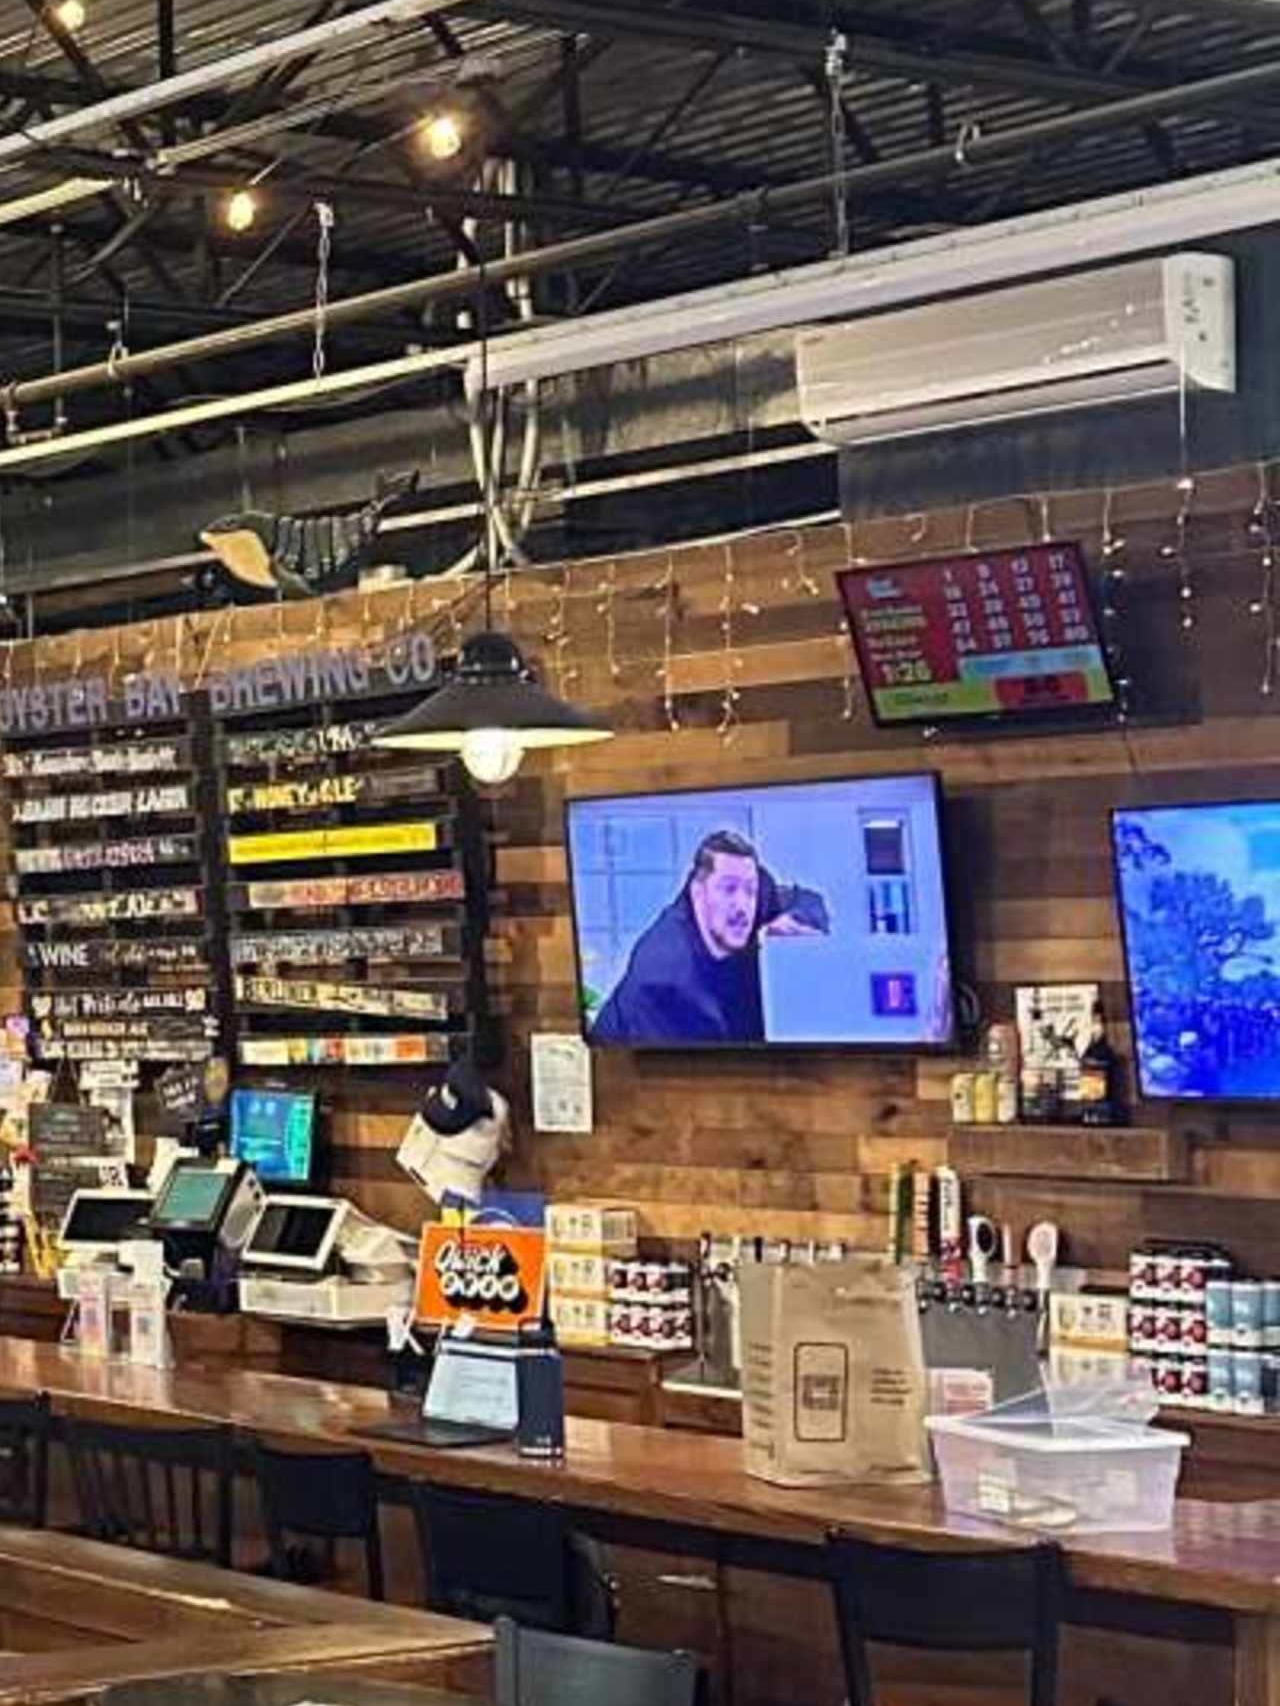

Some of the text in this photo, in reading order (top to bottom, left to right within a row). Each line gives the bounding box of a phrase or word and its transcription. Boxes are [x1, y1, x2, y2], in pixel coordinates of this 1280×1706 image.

[126, 671, 184, 718] BAY
[208, 647, 369, 713] BREWING
[385, 634, 434, 684] CO
[40, 942, 89, 968] WINE
